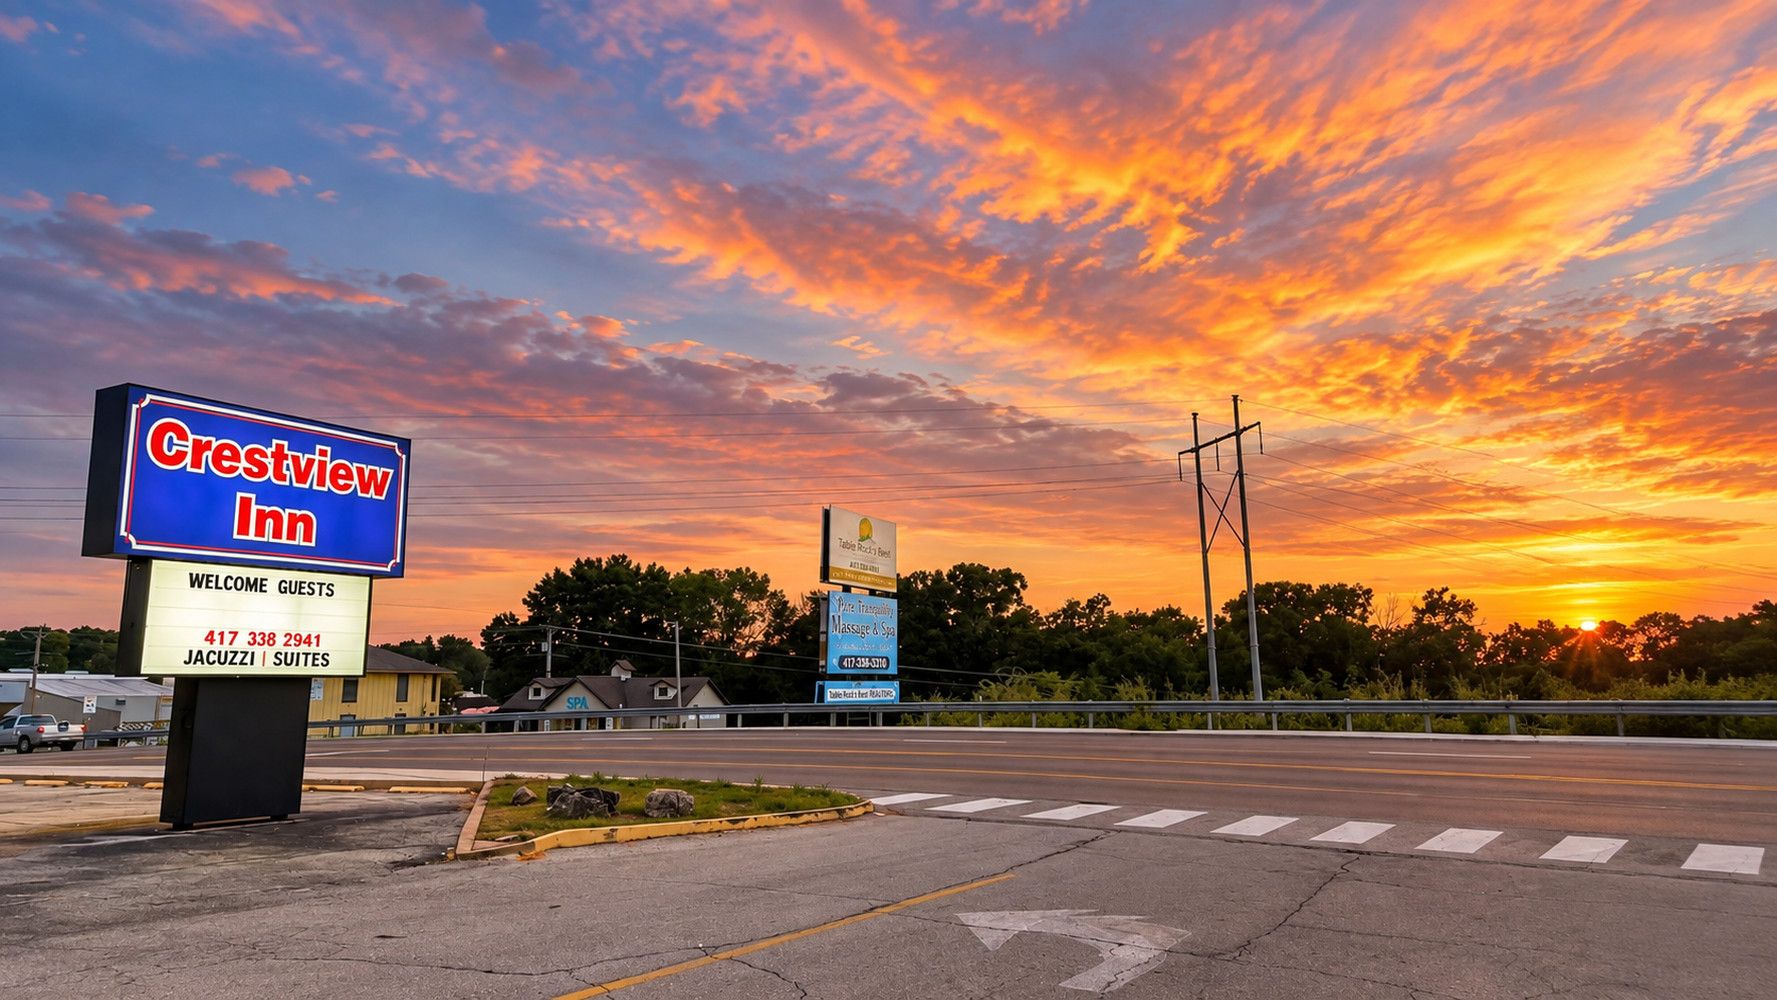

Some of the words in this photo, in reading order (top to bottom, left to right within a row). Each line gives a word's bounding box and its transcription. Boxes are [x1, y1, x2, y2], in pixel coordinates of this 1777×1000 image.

[146, 417, 393, 500] Crestview
[233, 491, 316, 547] Inn
[189, 572, 268, 593] WELCOME
[278, 579, 335, 597] GUESTS
[204, 630, 239, 646] 417
[247, 631, 276, 647] 338
[283, 632, 321, 648] 2941
[832, 614, 870, 639] Massage
[872, 622, 879, 636] &
[881, 621, 895, 638] Spa
[183, 649, 255, 666] JACUZZI
[273, 651, 330, 667] SUITES
[566, 695, 589, 710] SPA
